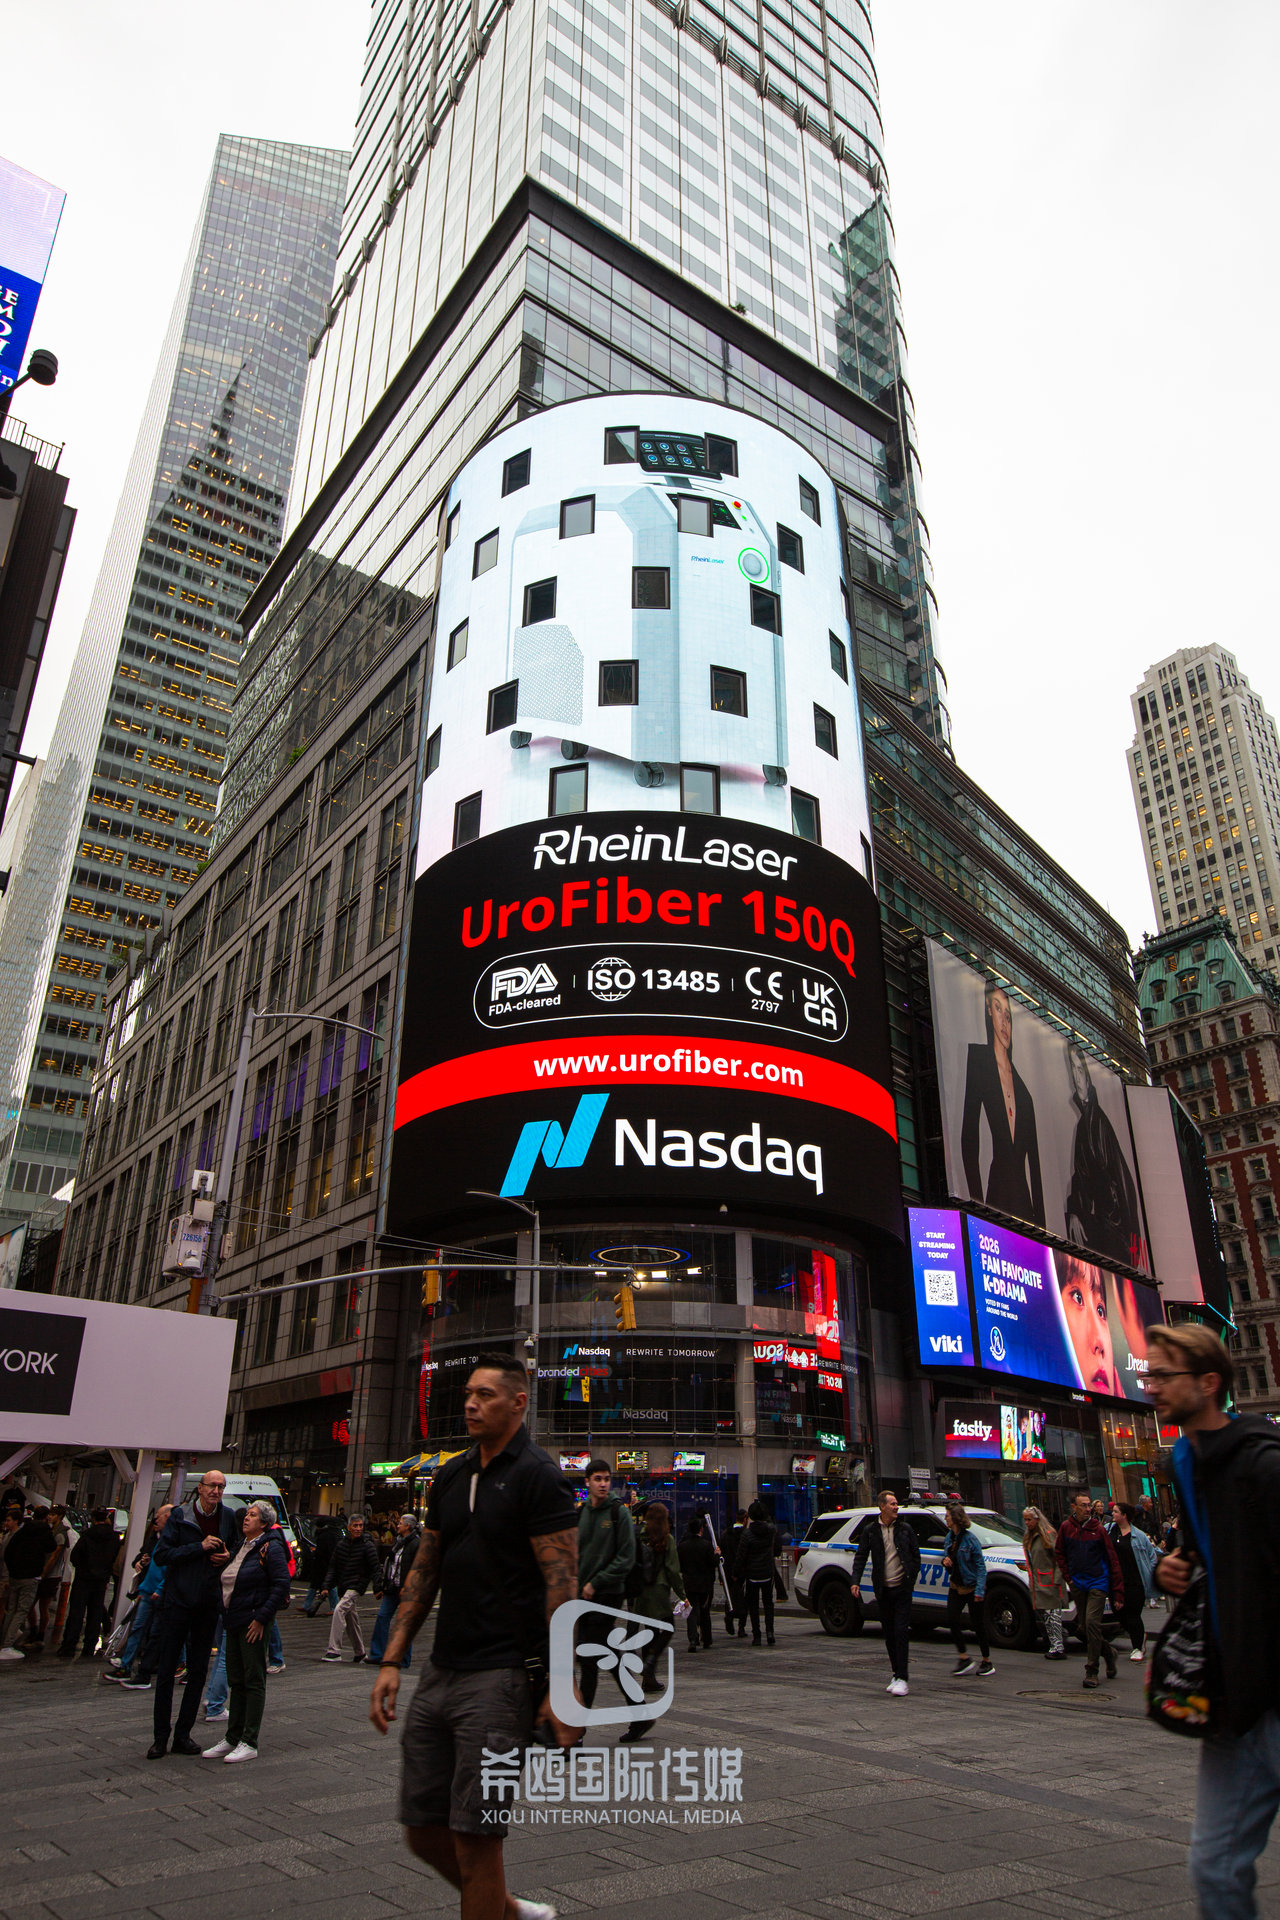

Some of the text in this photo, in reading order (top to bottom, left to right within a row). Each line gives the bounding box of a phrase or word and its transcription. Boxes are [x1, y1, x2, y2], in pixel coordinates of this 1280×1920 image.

[533, 825, 798, 881] RheinLaser
[461, 876, 856, 979] UroFiber 150Q
[491, 962, 559, 1002] FDA
[587, 968, 636, 991] ISO
[641, 968, 721, 993] 13485
[802, 977, 836, 1009] UK
[488, 994, 838, 1031] FDA-cleared 2797 CA
[533, 1048, 804, 1087] www.urofiber.com
[615, 1118, 824, 1196] Nasdaq
[918, 1241, 956, 1250] STREAMING
[926, 1232, 946, 1240] START
[978, 1233, 1000, 1255] 2026
[927, 1251, 949, 1259] TODAY
[980, 1252, 1043, 1290] FAN FAVORITE
[982, 1273, 1028, 1304] K-DRAMA
[578, 1346, 716, 1358] Nasdaq REWRITE TOMORROW
[623, 1408, 669, 1422] Nasdaq
